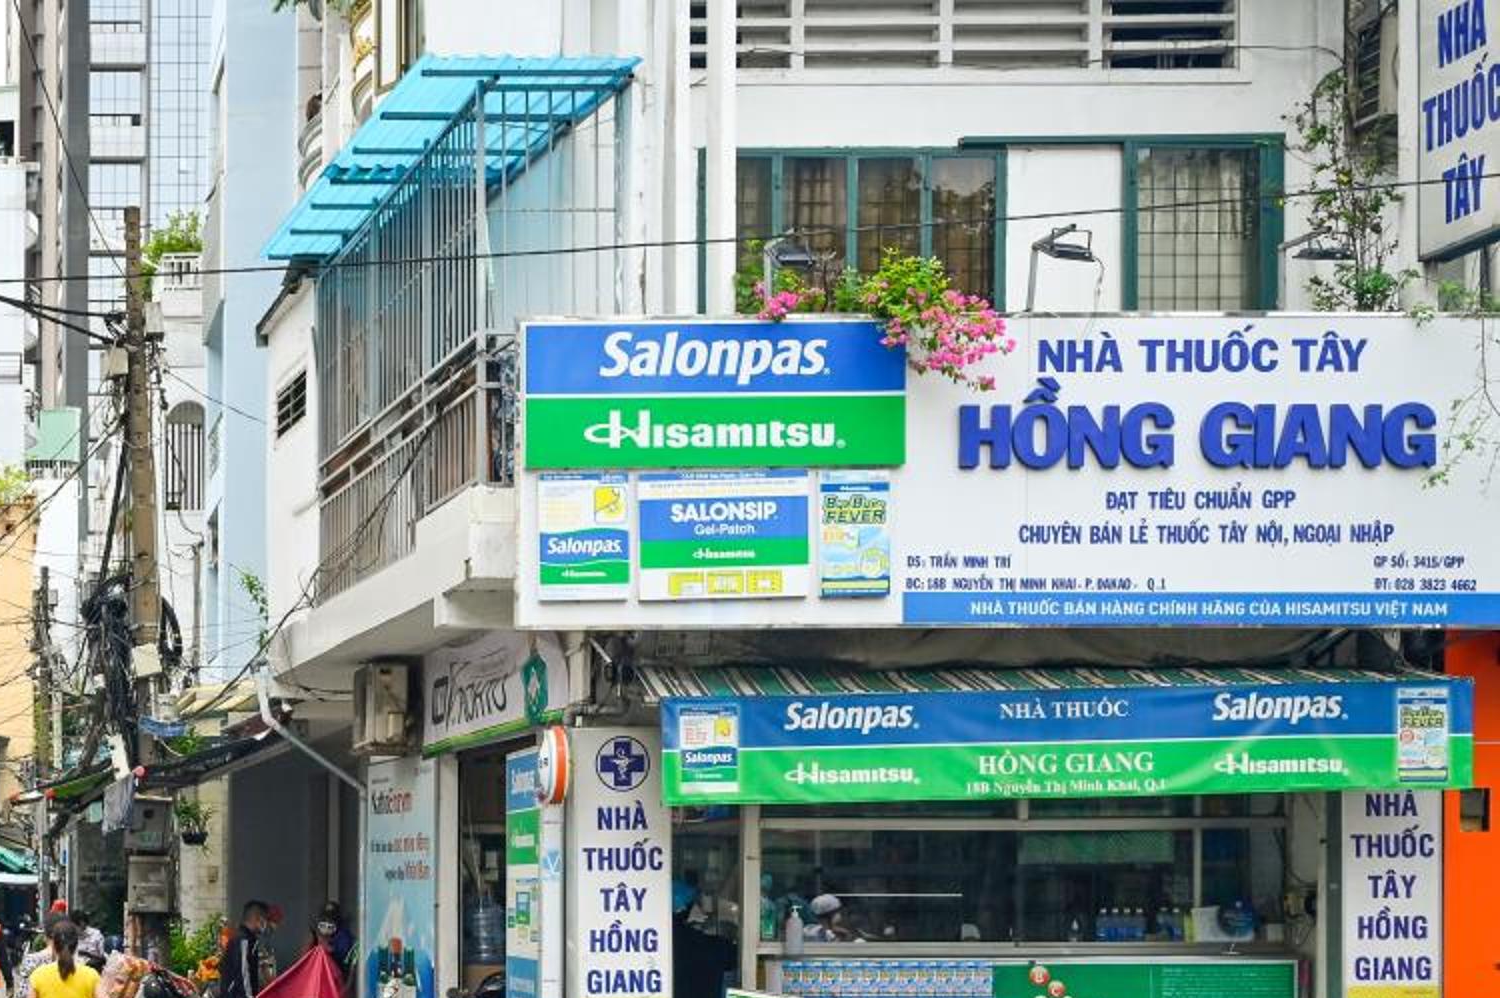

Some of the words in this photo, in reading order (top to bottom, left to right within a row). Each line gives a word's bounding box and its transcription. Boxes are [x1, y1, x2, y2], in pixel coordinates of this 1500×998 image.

[1422, 52, 1500, 152] THUỐC
[1442, 152, 1485, 224] TÂY
[599, 331, 828, 385] Salonpas
[1037, 332, 1123, 373] NHÀ
[1140, 326, 1278, 373] THUỐC
[1292, 330, 1367, 373] TÂY
[584, 410, 840, 448] Hisamitsu
[957, 377, 1175, 470] HỒNG
[1200, 402, 1438, 470] GIANG
[670, 501, 778, 522] SALONSIP
[1106, 491, 1138, 513] ĐẠT
[1148, 488, 1185, 509] TIÊU
[1194, 483, 1252, 510] CHUẨN
[1262, 491, 1296, 509] GPP
[694, 523, 755, 536] Gel-Patch
[1019, 520, 1081, 544] CHUYÊN
[1090, 520, 1122, 543] BÁN
[1129, 520, 1148, 543] LẺ
[1159, 517, 1209, 543] THUỐC
[1219, 520, 1248, 543] TÂY
[1294, 524, 1341, 546] NGOẠI
[1351, 523, 1395, 546] NHẬP
[548, 538, 622, 556] Salonpas
[964, 556, 988, 568] MINH
[1020, 577, 1047, 590] MINH
[1420, 578, 1446, 590] 3823
[1451, 578, 1477, 591] 4662
[970, 597, 1003, 615] NHÀ
[1008, 597, 1064, 615] THUỐC
[1065, 597, 1096, 615] BÁN
[1102, 597, 1144, 615] HÀNG
[1150, 597, 1197, 615] CHÍNH
[1250, 597, 1280, 615] CỦA
[1285, 600, 1370, 615] HISAMITSU
[1376, 598, 1407, 619] VIỆT
[1412, 601, 1448, 615] NAM
[784, 702, 919, 734] Salonpas
[1000, 697, 1043, 719] NHÀ
[1049, 695, 1130, 718] THUỐC
[1212, 692, 1347, 724] Salonpas
[784, 763, 920, 785] Hisamitsu
[1065, 752, 1155, 773] GIANG
[1213, 752, 1348, 775] Hisamitsu
[1072, 779, 1103, 792] Minh
[597, 800, 648, 831] NHÀ
[583, 838, 663, 871] THUỐC
[1351, 825, 1434, 858] THUỐC
[600, 882, 647, 912] TÂY
[1368, 870, 1416, 898] TÂY
[590, 920, 658, 953] HỒNG
[1358, 906, 1428, 940] HỒNG
[587, 969, 662, 994] GIANG
[1355, 957, 1431, 981] GIANG
